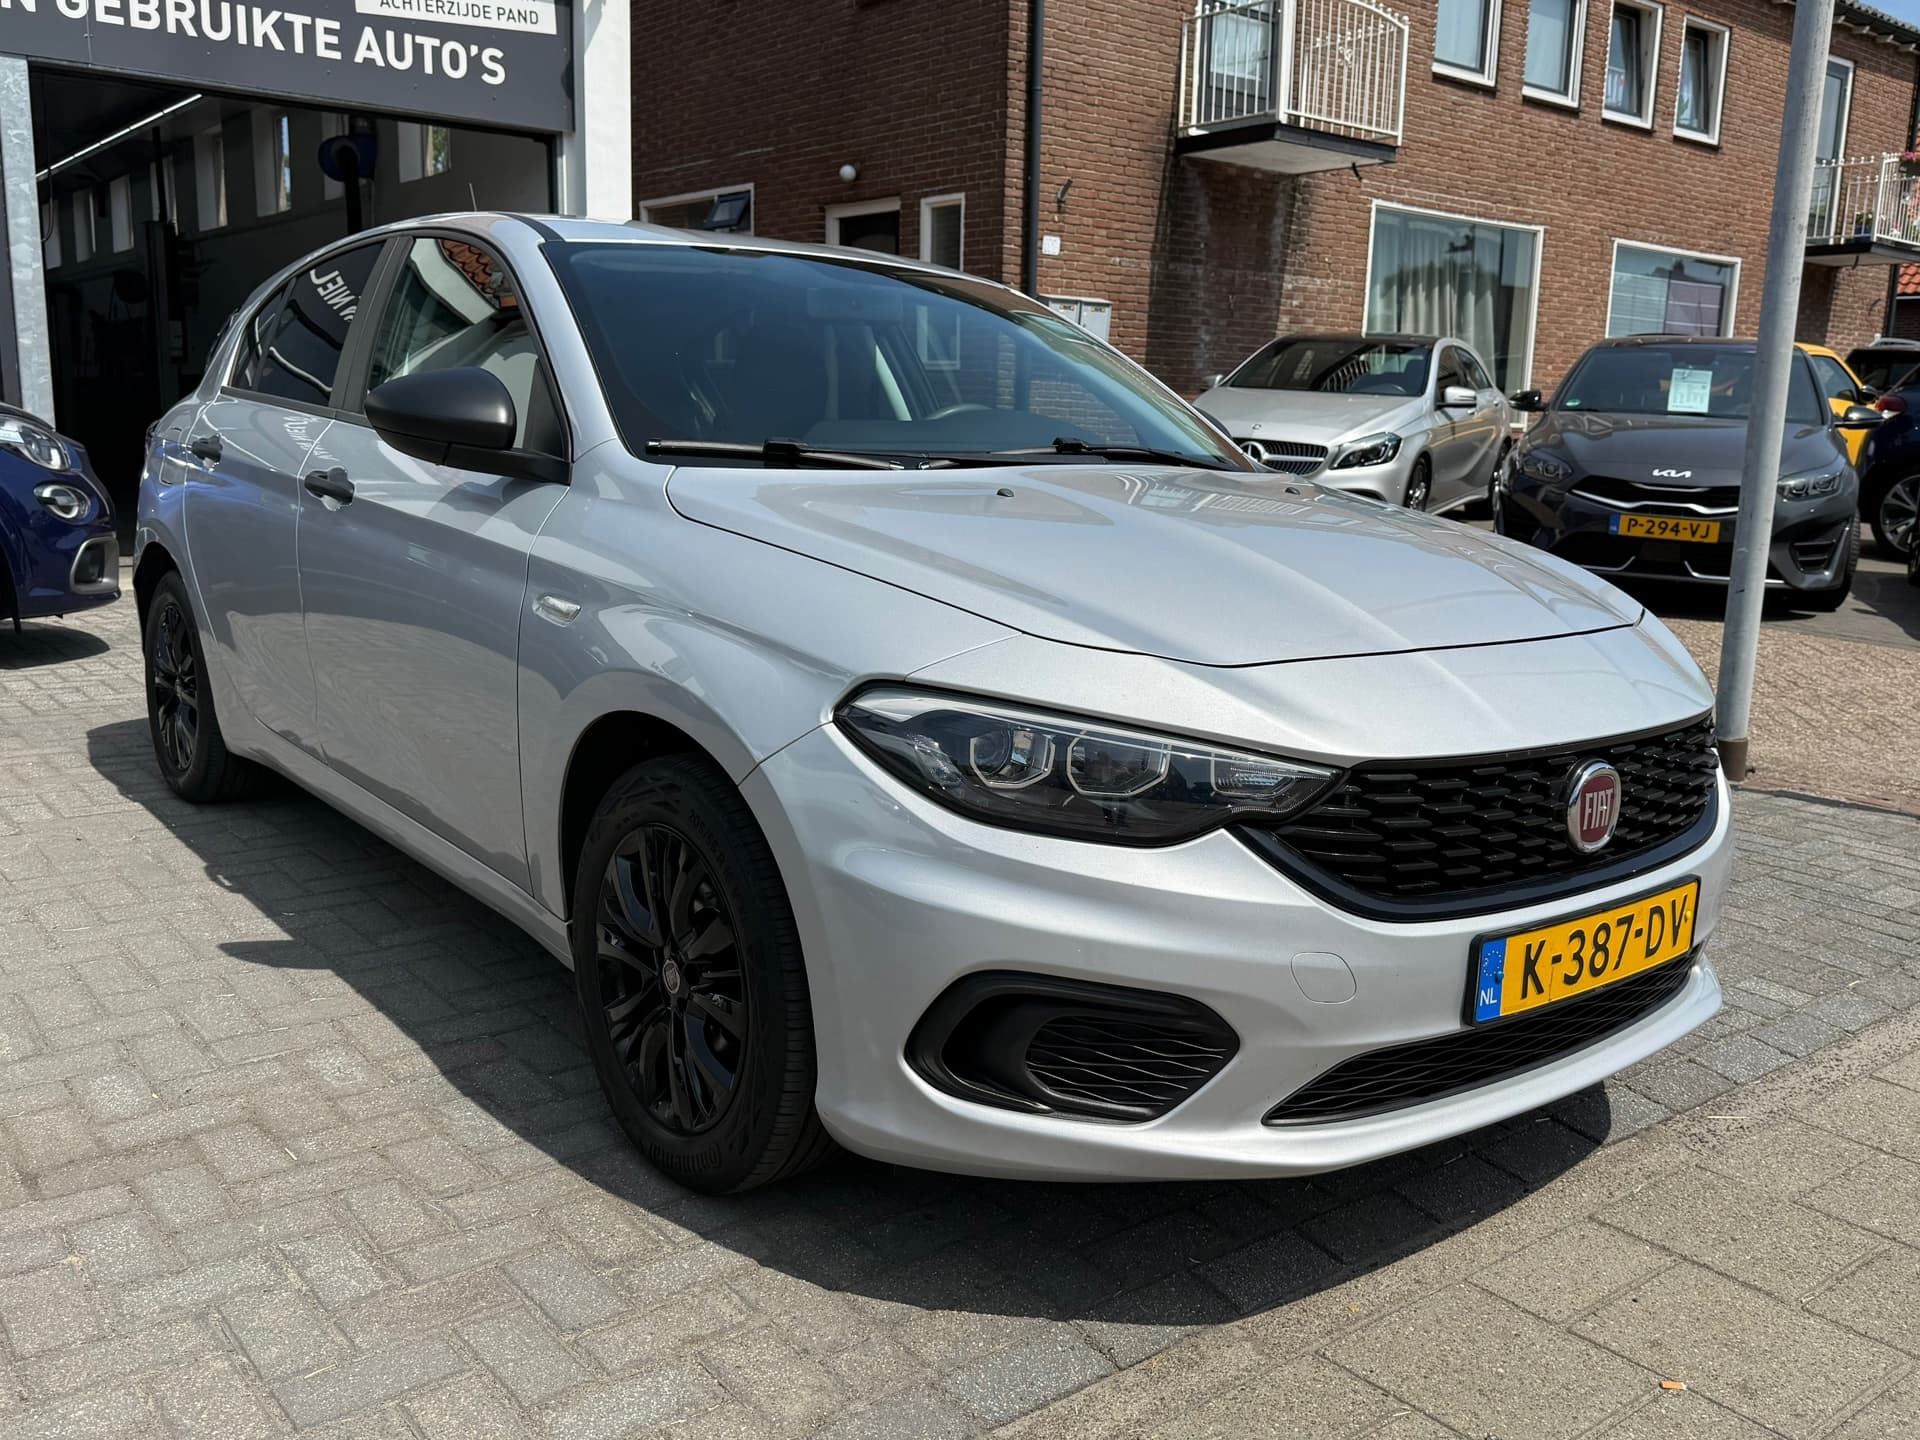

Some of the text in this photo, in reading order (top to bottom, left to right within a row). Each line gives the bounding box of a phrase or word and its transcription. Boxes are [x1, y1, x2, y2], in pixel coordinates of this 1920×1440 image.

[380, 0, 539, 25] ACHTERZIJDE PAND
[56, 0, 506, 85] GEBRUIKTE AUTO'S
[1627, 517, 1710, 539] P-294-VJ
[1583, 787, 1614, 831] FIAT
[1520, 894, 1688, 1000] K-387-DV
[1479, 987, 1497, 1007] NL
